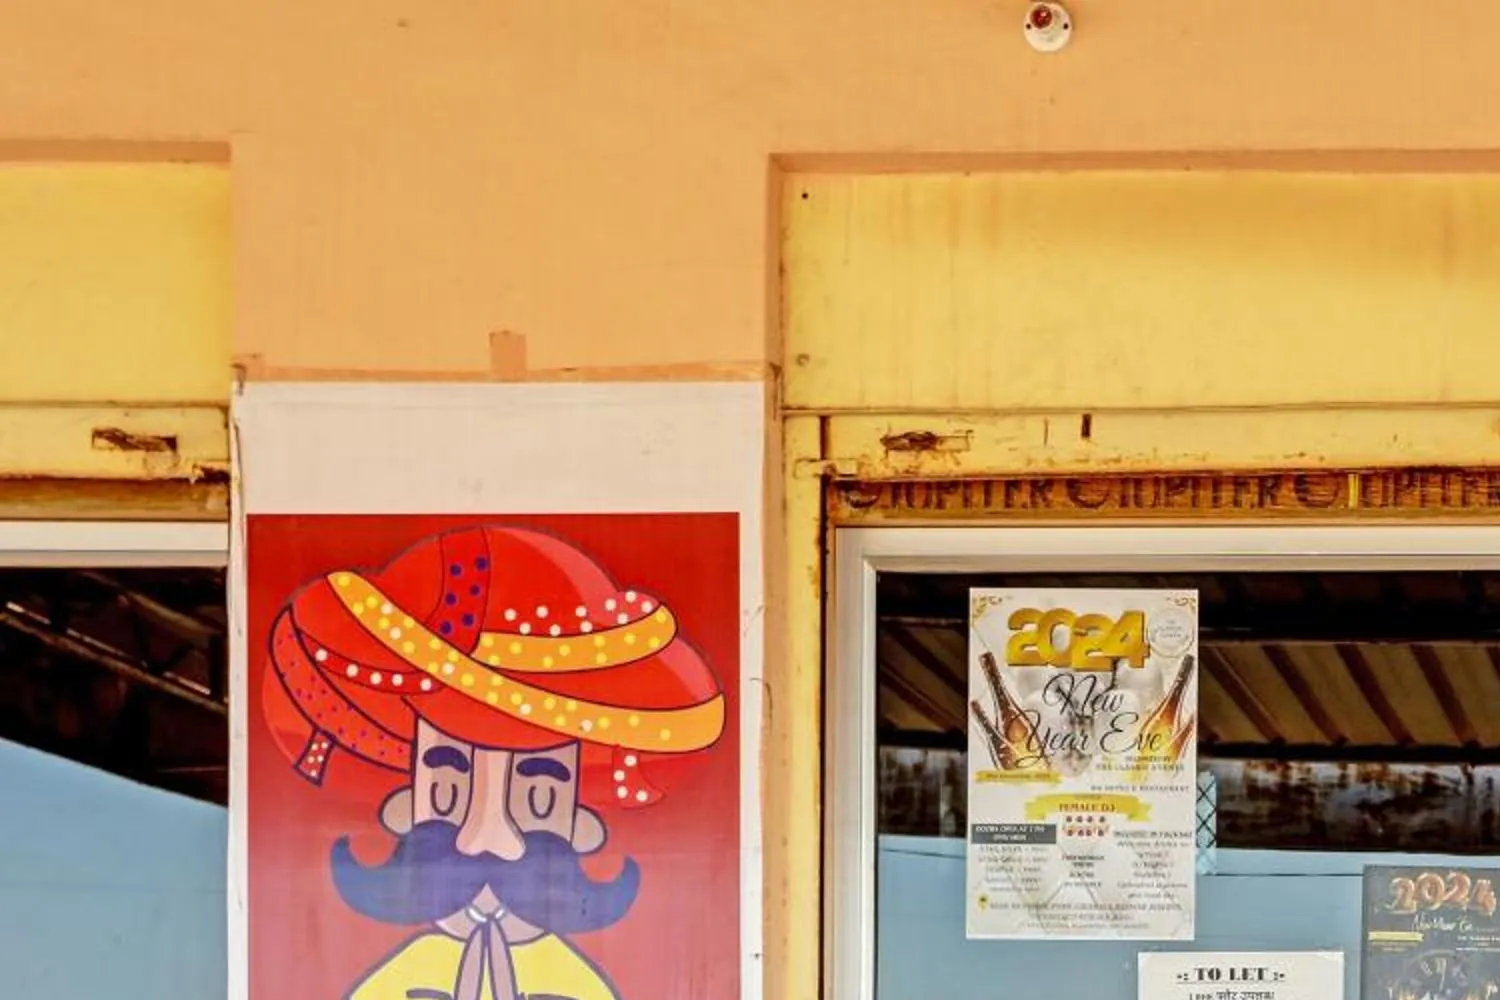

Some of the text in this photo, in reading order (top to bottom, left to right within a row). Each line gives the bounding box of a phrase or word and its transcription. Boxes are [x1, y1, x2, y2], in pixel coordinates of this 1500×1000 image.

[1006, 607, 1150, 672] 2024
[1043, 673, 1124, 716] New
[1005, 709, 1091, 768] Year
[1194, 967, 1222, 982] TO
[1228, 967, 1269, 982] LET
